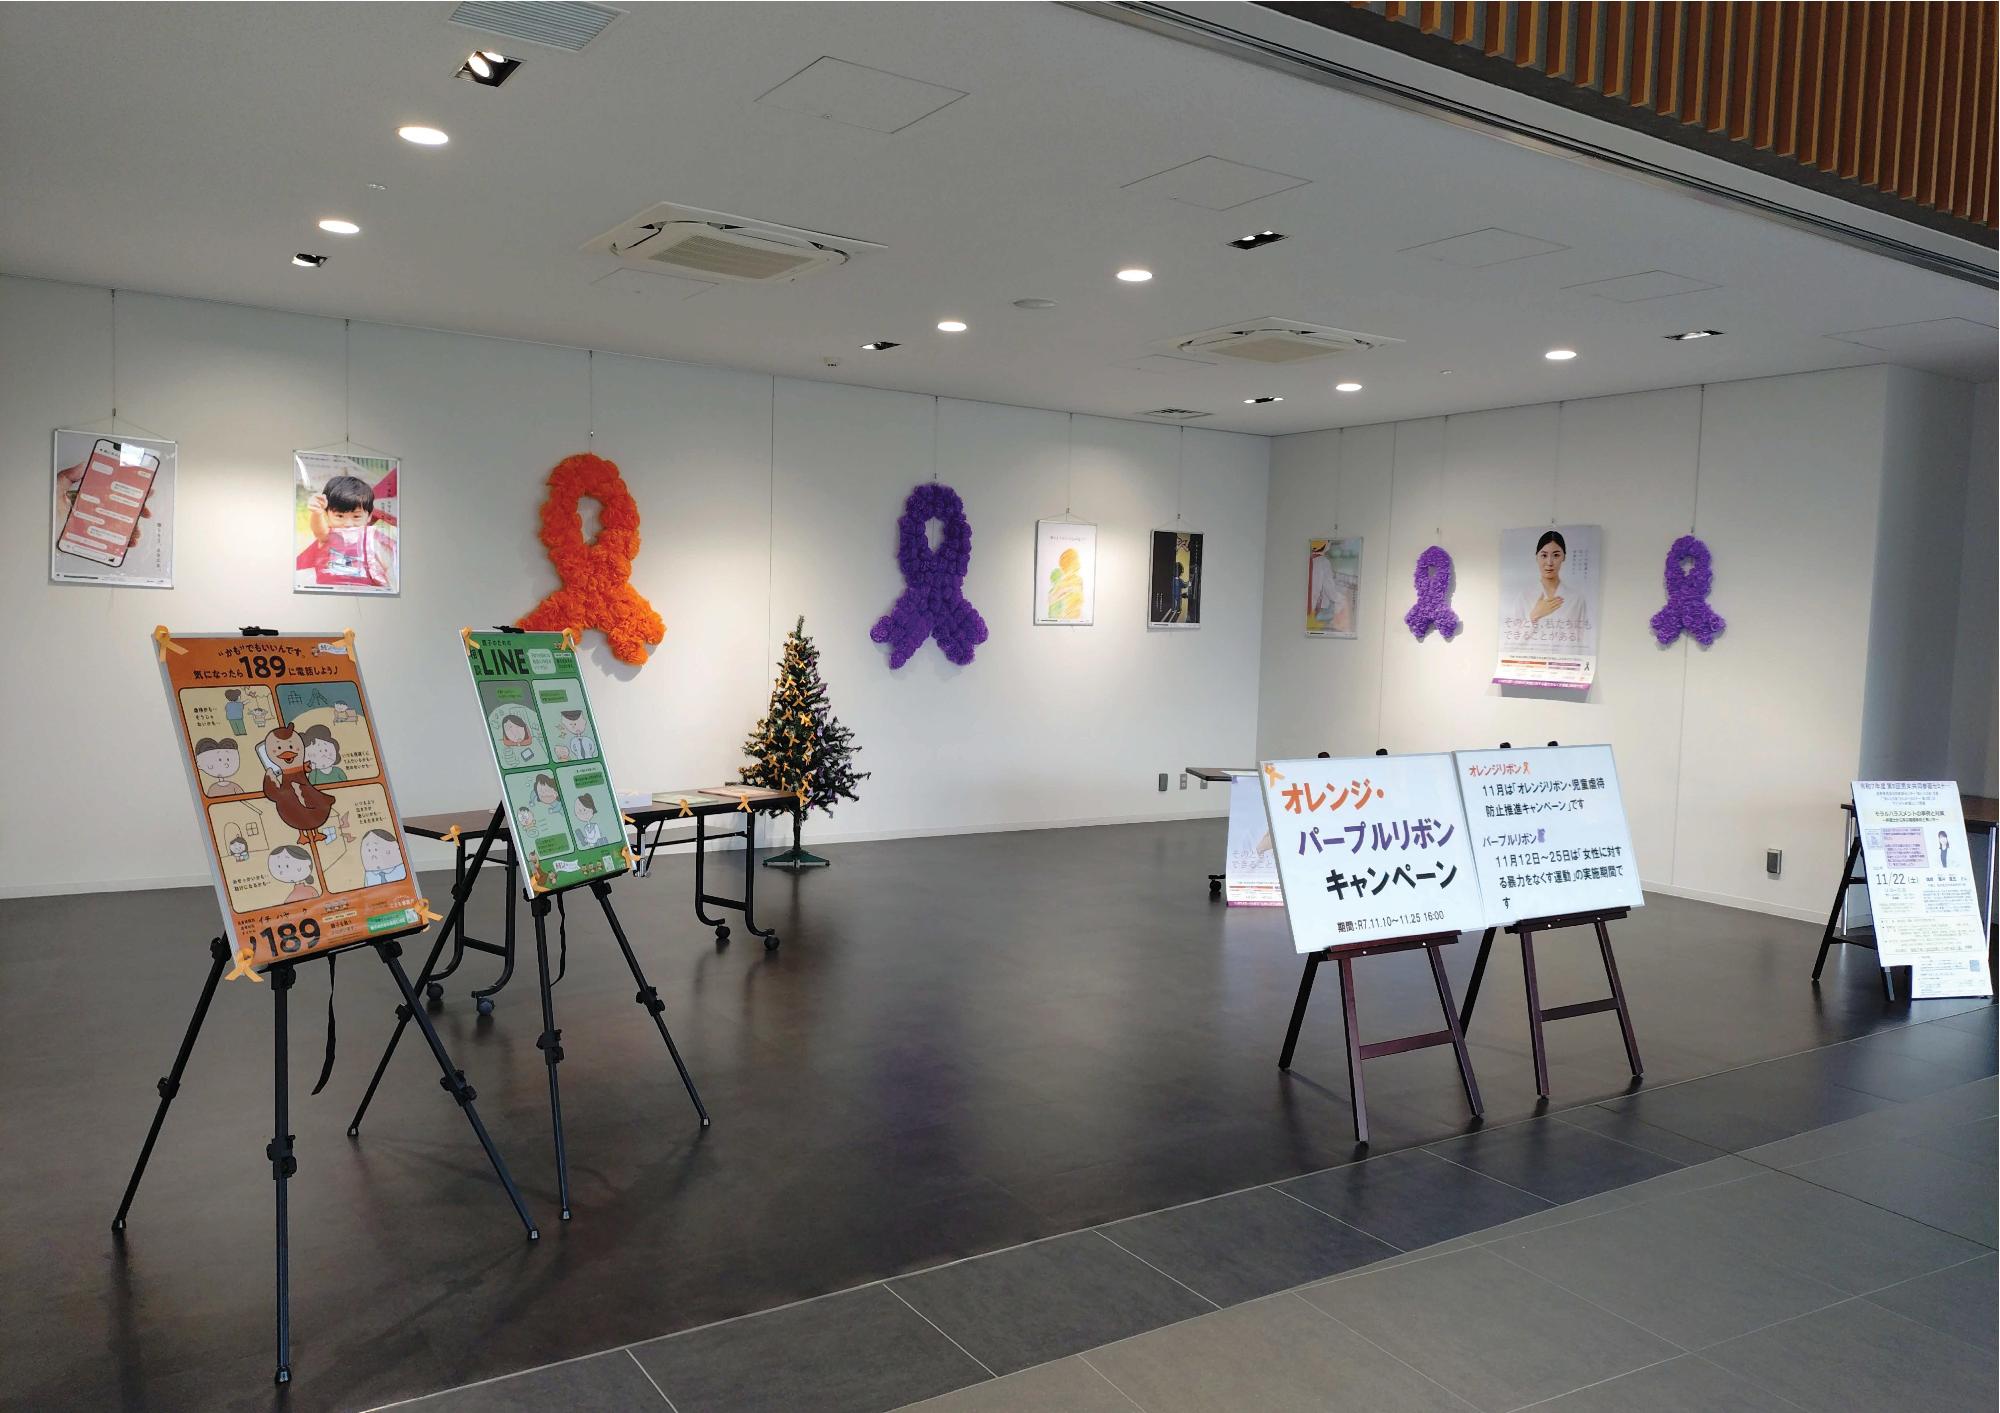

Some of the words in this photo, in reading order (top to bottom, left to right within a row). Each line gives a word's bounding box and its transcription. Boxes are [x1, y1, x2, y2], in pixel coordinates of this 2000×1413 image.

[1503, 616, 1592, 630] そのとき、私たちにも
[478, 648, 530, 676] LINE
[1469, 763, 1522, 777] オレンジリボン
[1281, 778, 1385, 814] オレンジ・
[1485, 798, 1585, 818] 防止推進キャンペーン」です
[1298, 818, 1455, 856] パープルリボン
[1325, 860, 1458, 900] キャンペーン
[1499, 865, 1624, 889] る暴力をなくす運動」の実施期間で
[1876, 872, 1906, 886] 11/22
[1502, 897, 1511, 909] す
[1424, 910, 1445, 922] 16:00
